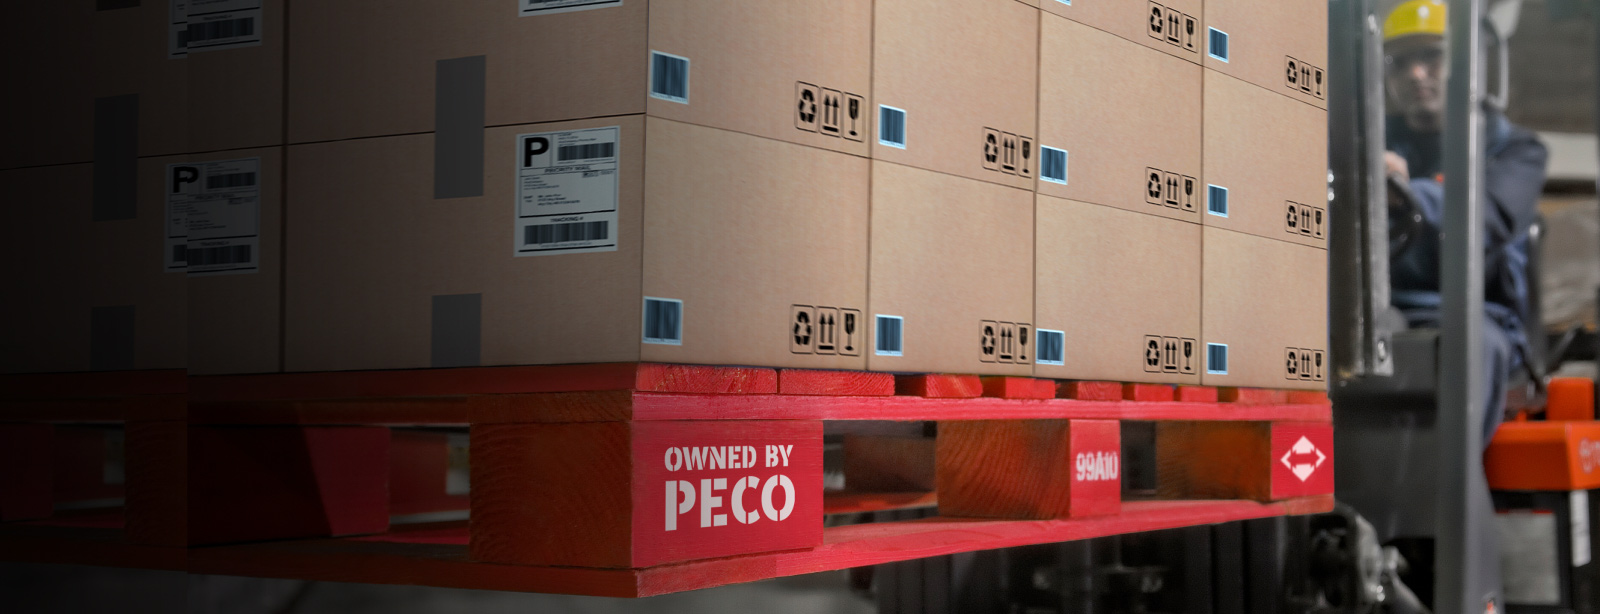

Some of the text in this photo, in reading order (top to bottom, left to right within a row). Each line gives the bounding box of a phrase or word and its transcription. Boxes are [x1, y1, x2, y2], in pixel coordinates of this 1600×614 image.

[524, 137, 549, 167] P
[664, 444, 794, 472] OWNED BY
[1075, 450, 1119, 482] 99A10
[664, 474, 796, 532] PECO
